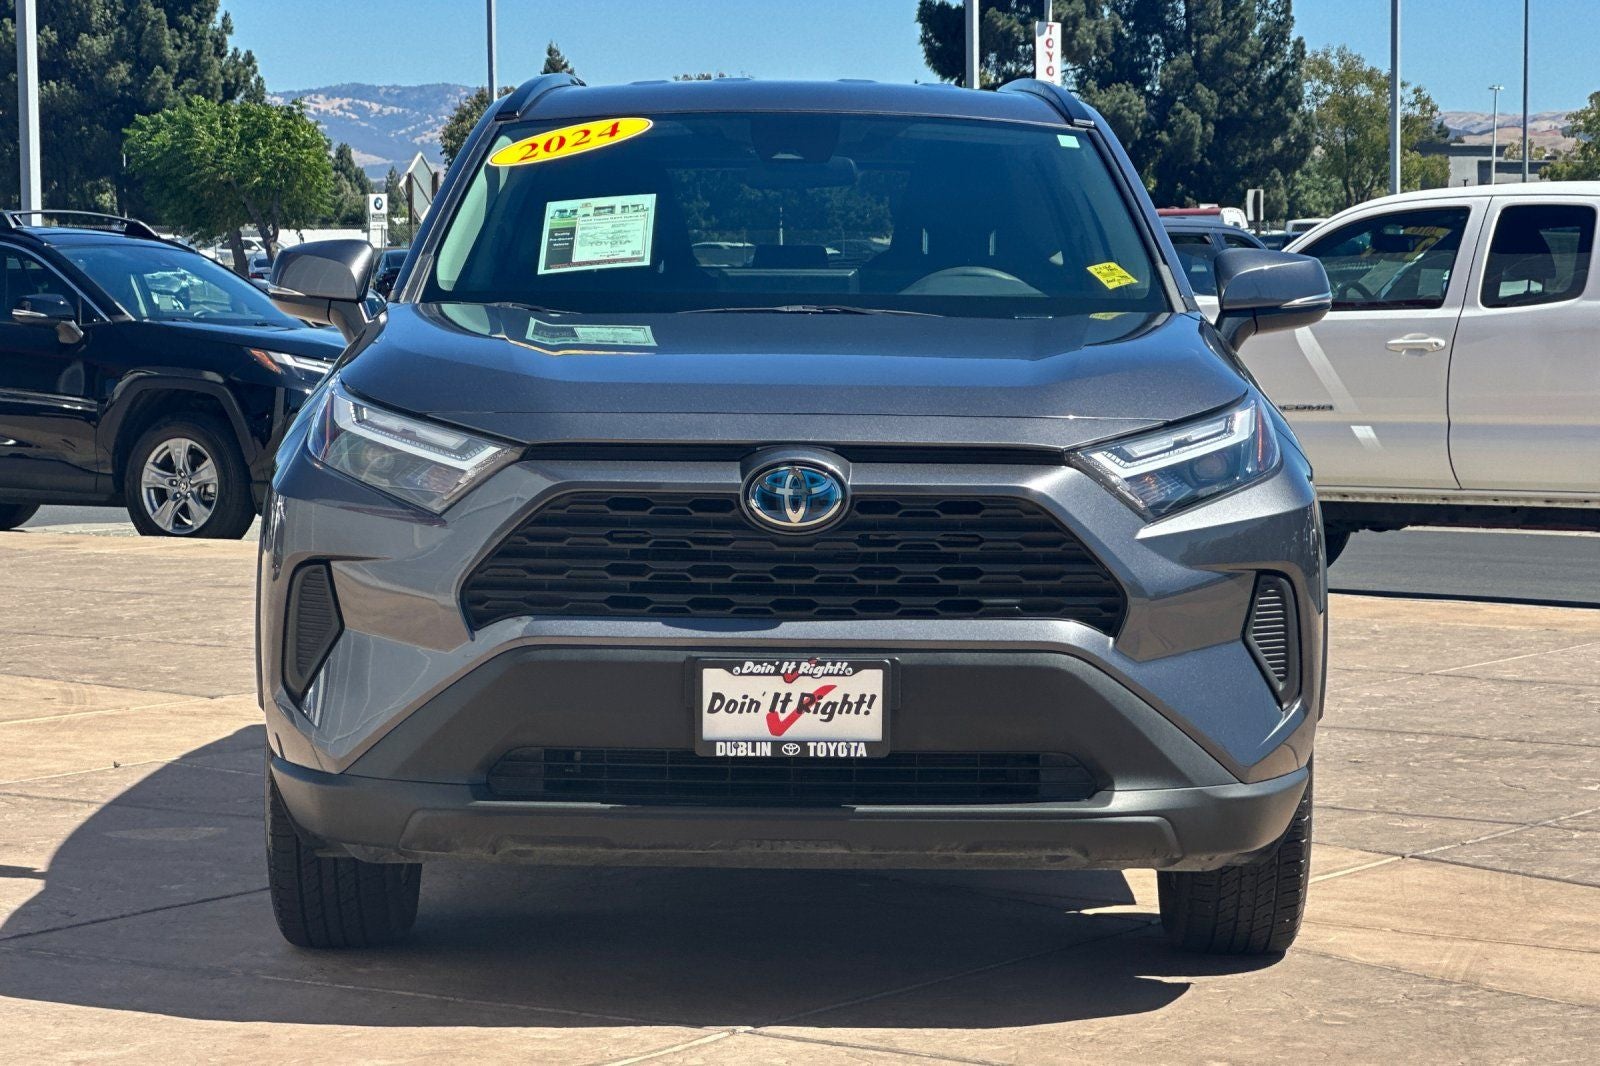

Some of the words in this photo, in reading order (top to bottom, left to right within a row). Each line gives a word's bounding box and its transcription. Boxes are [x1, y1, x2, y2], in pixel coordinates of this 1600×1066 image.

[1045, 24, 1055, 83] TOYO
[517, 121, 620, 163] 2024
[741, 661, 779, 675] Doin'
[779, 660, 798, 675] It
[797, 661, 849, 679] Right!
[707, 690, 767, 715] Doin'
[768, 691, 794, 714] It
[796, 692, 878, 722] Right!
[715, 741, 773, 757] DUBLIN
[806, 741, 868, 757] TOYOTA
